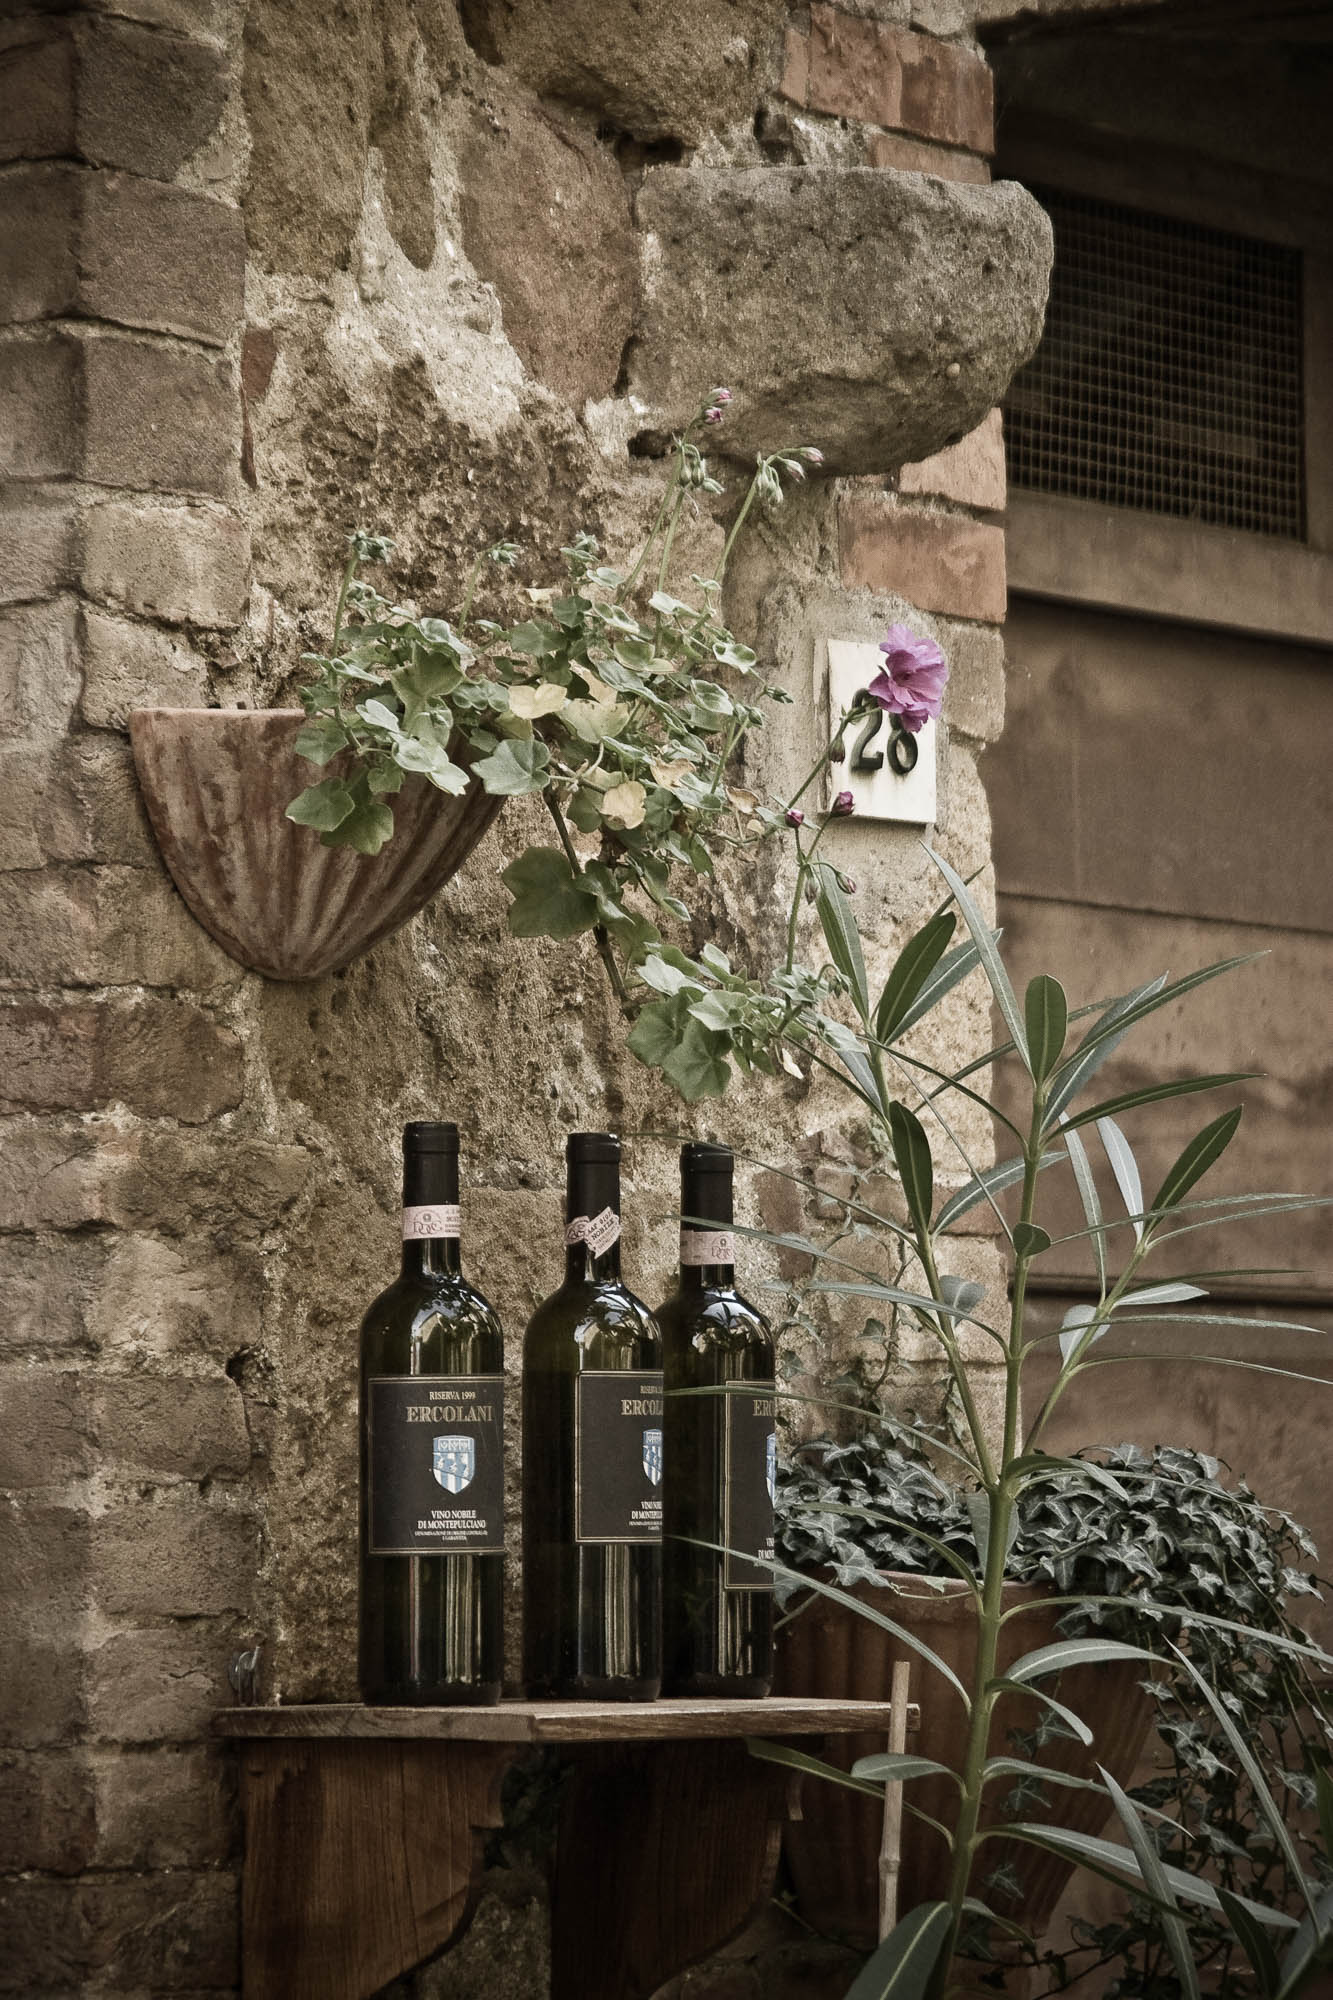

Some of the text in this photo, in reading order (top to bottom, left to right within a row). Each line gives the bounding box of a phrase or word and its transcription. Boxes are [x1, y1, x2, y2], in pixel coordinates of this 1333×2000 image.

[429, 1391, 476, 1400] RISERVA 1999
[620, 1399, 664, 1416] ERCOL
[406, 1405, 492, 1422] ERCOLANI
[431, 1510, 477, 1519] VINO NOBILE
[417, 1520, 486, 1530] DI MONTEPULCIANO
